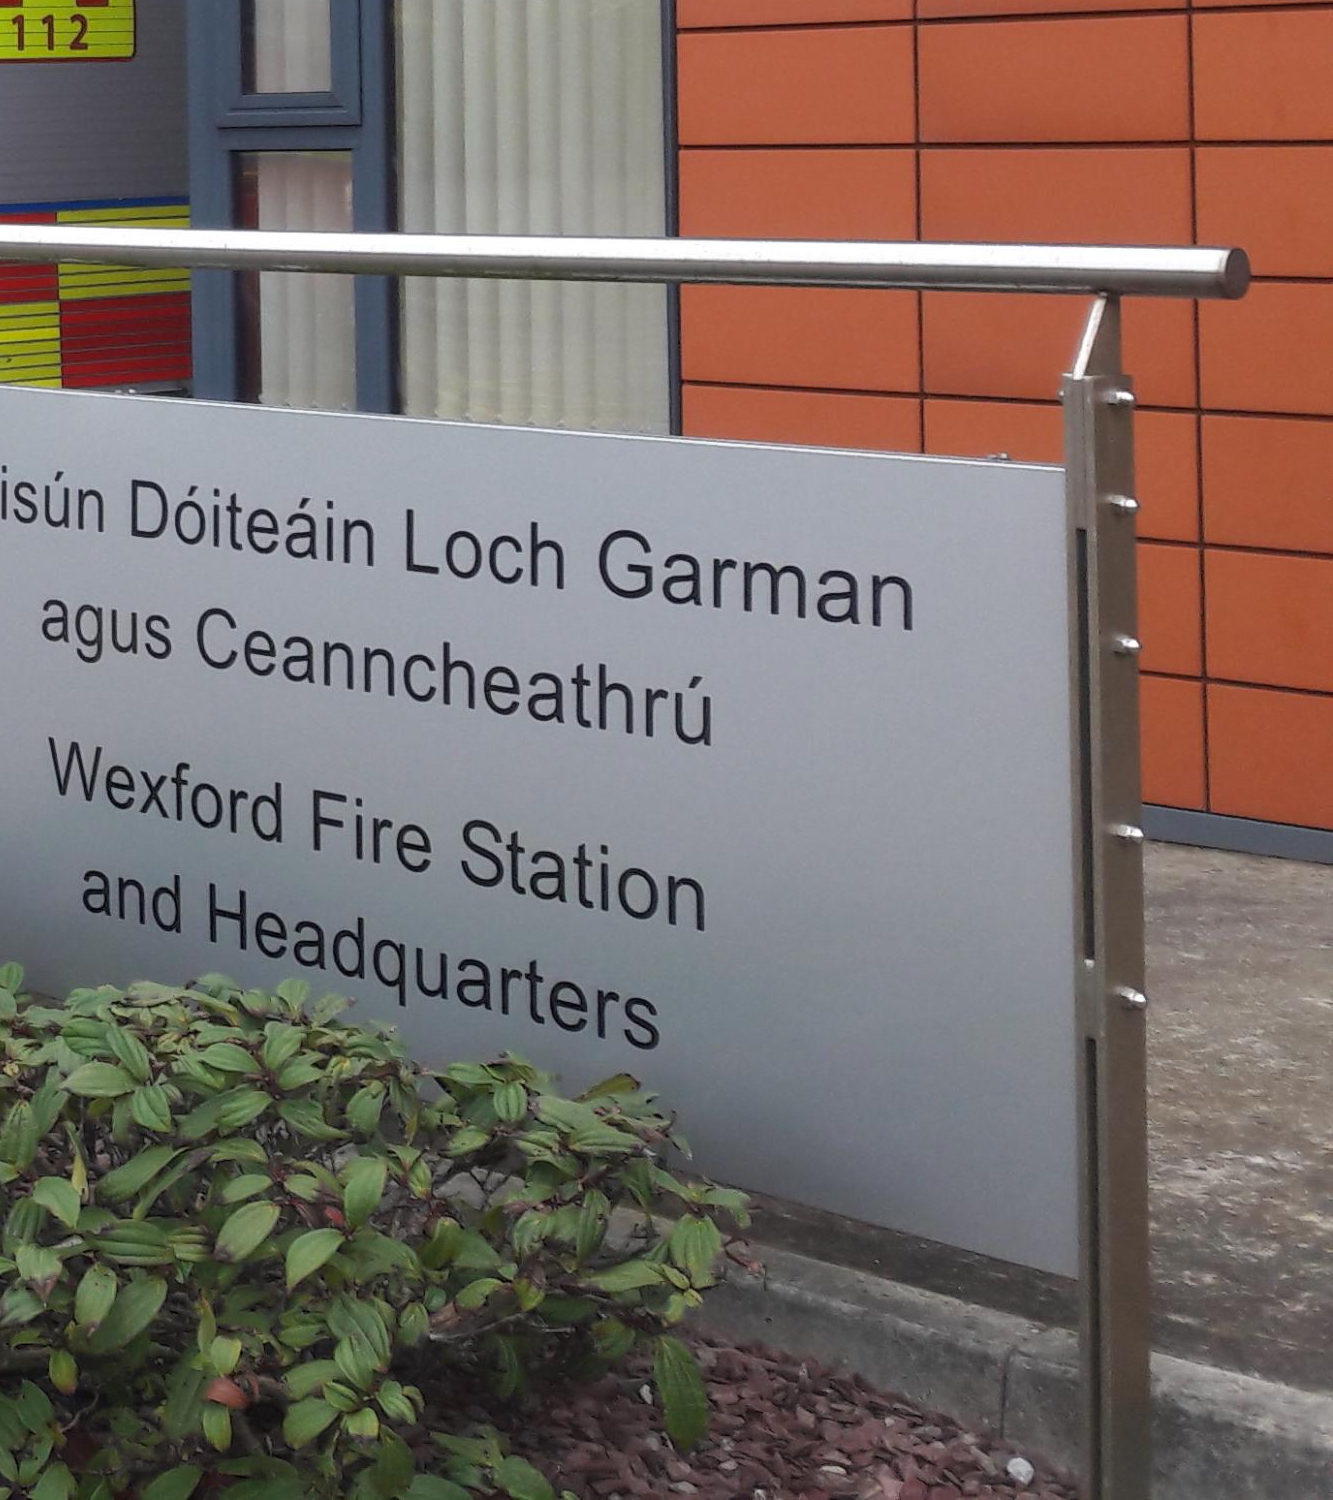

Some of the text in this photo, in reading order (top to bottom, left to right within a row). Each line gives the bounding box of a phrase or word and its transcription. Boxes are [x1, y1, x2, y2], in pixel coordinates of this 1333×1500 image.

[131, 479, 374, 567] Dóiteáin
[406, 509, 564, 590] Loch
[598, 530, 913, 631] Garman
[42, 599, 711, 746] agus Ceanncheathrú
[48, 736, 705, 932] Wexford Fire Station
[82, 869, 660, 1051] and Headquarters
